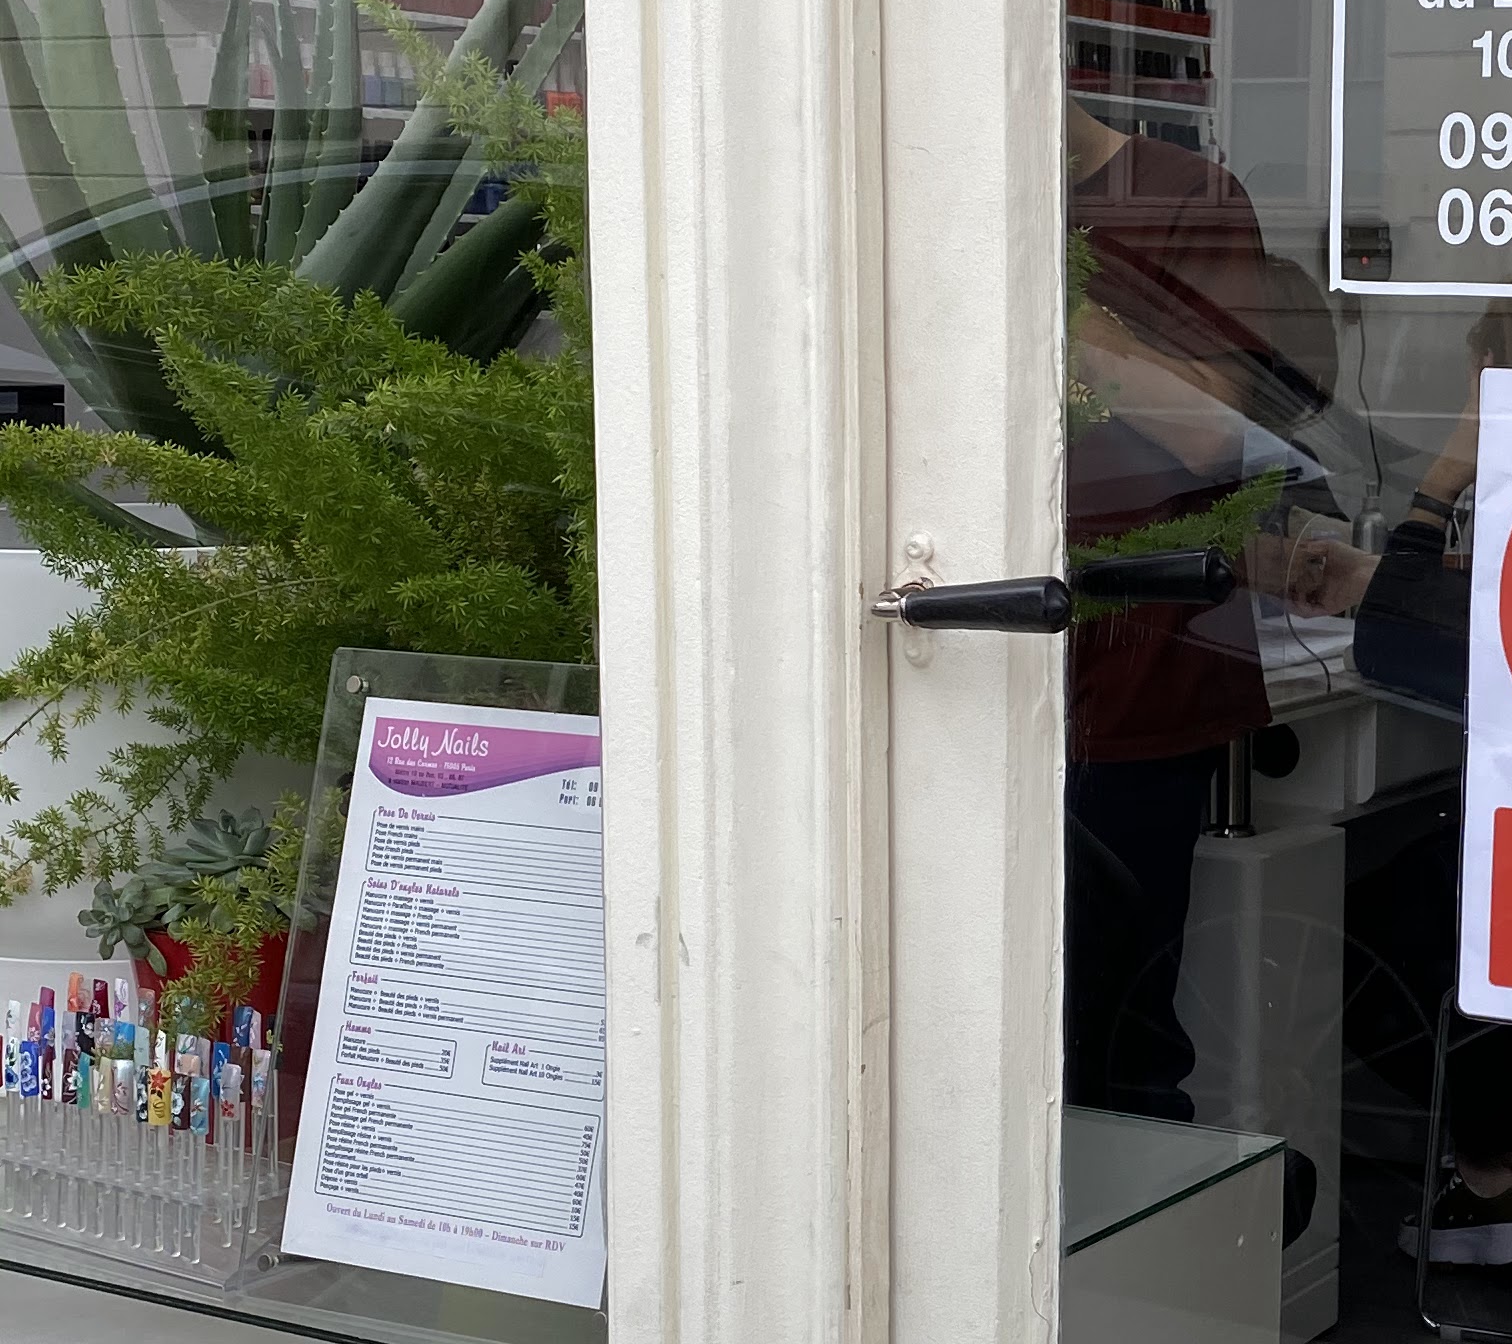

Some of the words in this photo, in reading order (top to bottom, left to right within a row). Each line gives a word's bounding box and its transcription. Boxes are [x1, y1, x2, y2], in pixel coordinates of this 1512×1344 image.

[378, 726, 429, 758] Jolly
[431, 728, 488, 756] Nails
[562, 779, 577, 790] Tél:
[589, 782, 598, 792] 09
[559, 794, 579, 805] Port:
[587, 796, 596, 806] 06
[378, 806, 395, 817] Pose
[412, 809, 435, 821] Vernis
[492, 1041, 510, 1052] Nail
[511, 1043, 526, 1055] Art
[326, 1203, 350, 1216] Ouvert
[353, 1207, 361, 1217] du
[364, 1209, 385, 1221] Lundi
[398, 1215, 425, 1228] Samedi
[427, 1220, 436, 1230] de
[491, 1231, 528, 1246] Dimanche
[545, 1240, 566, 1252] RDV
